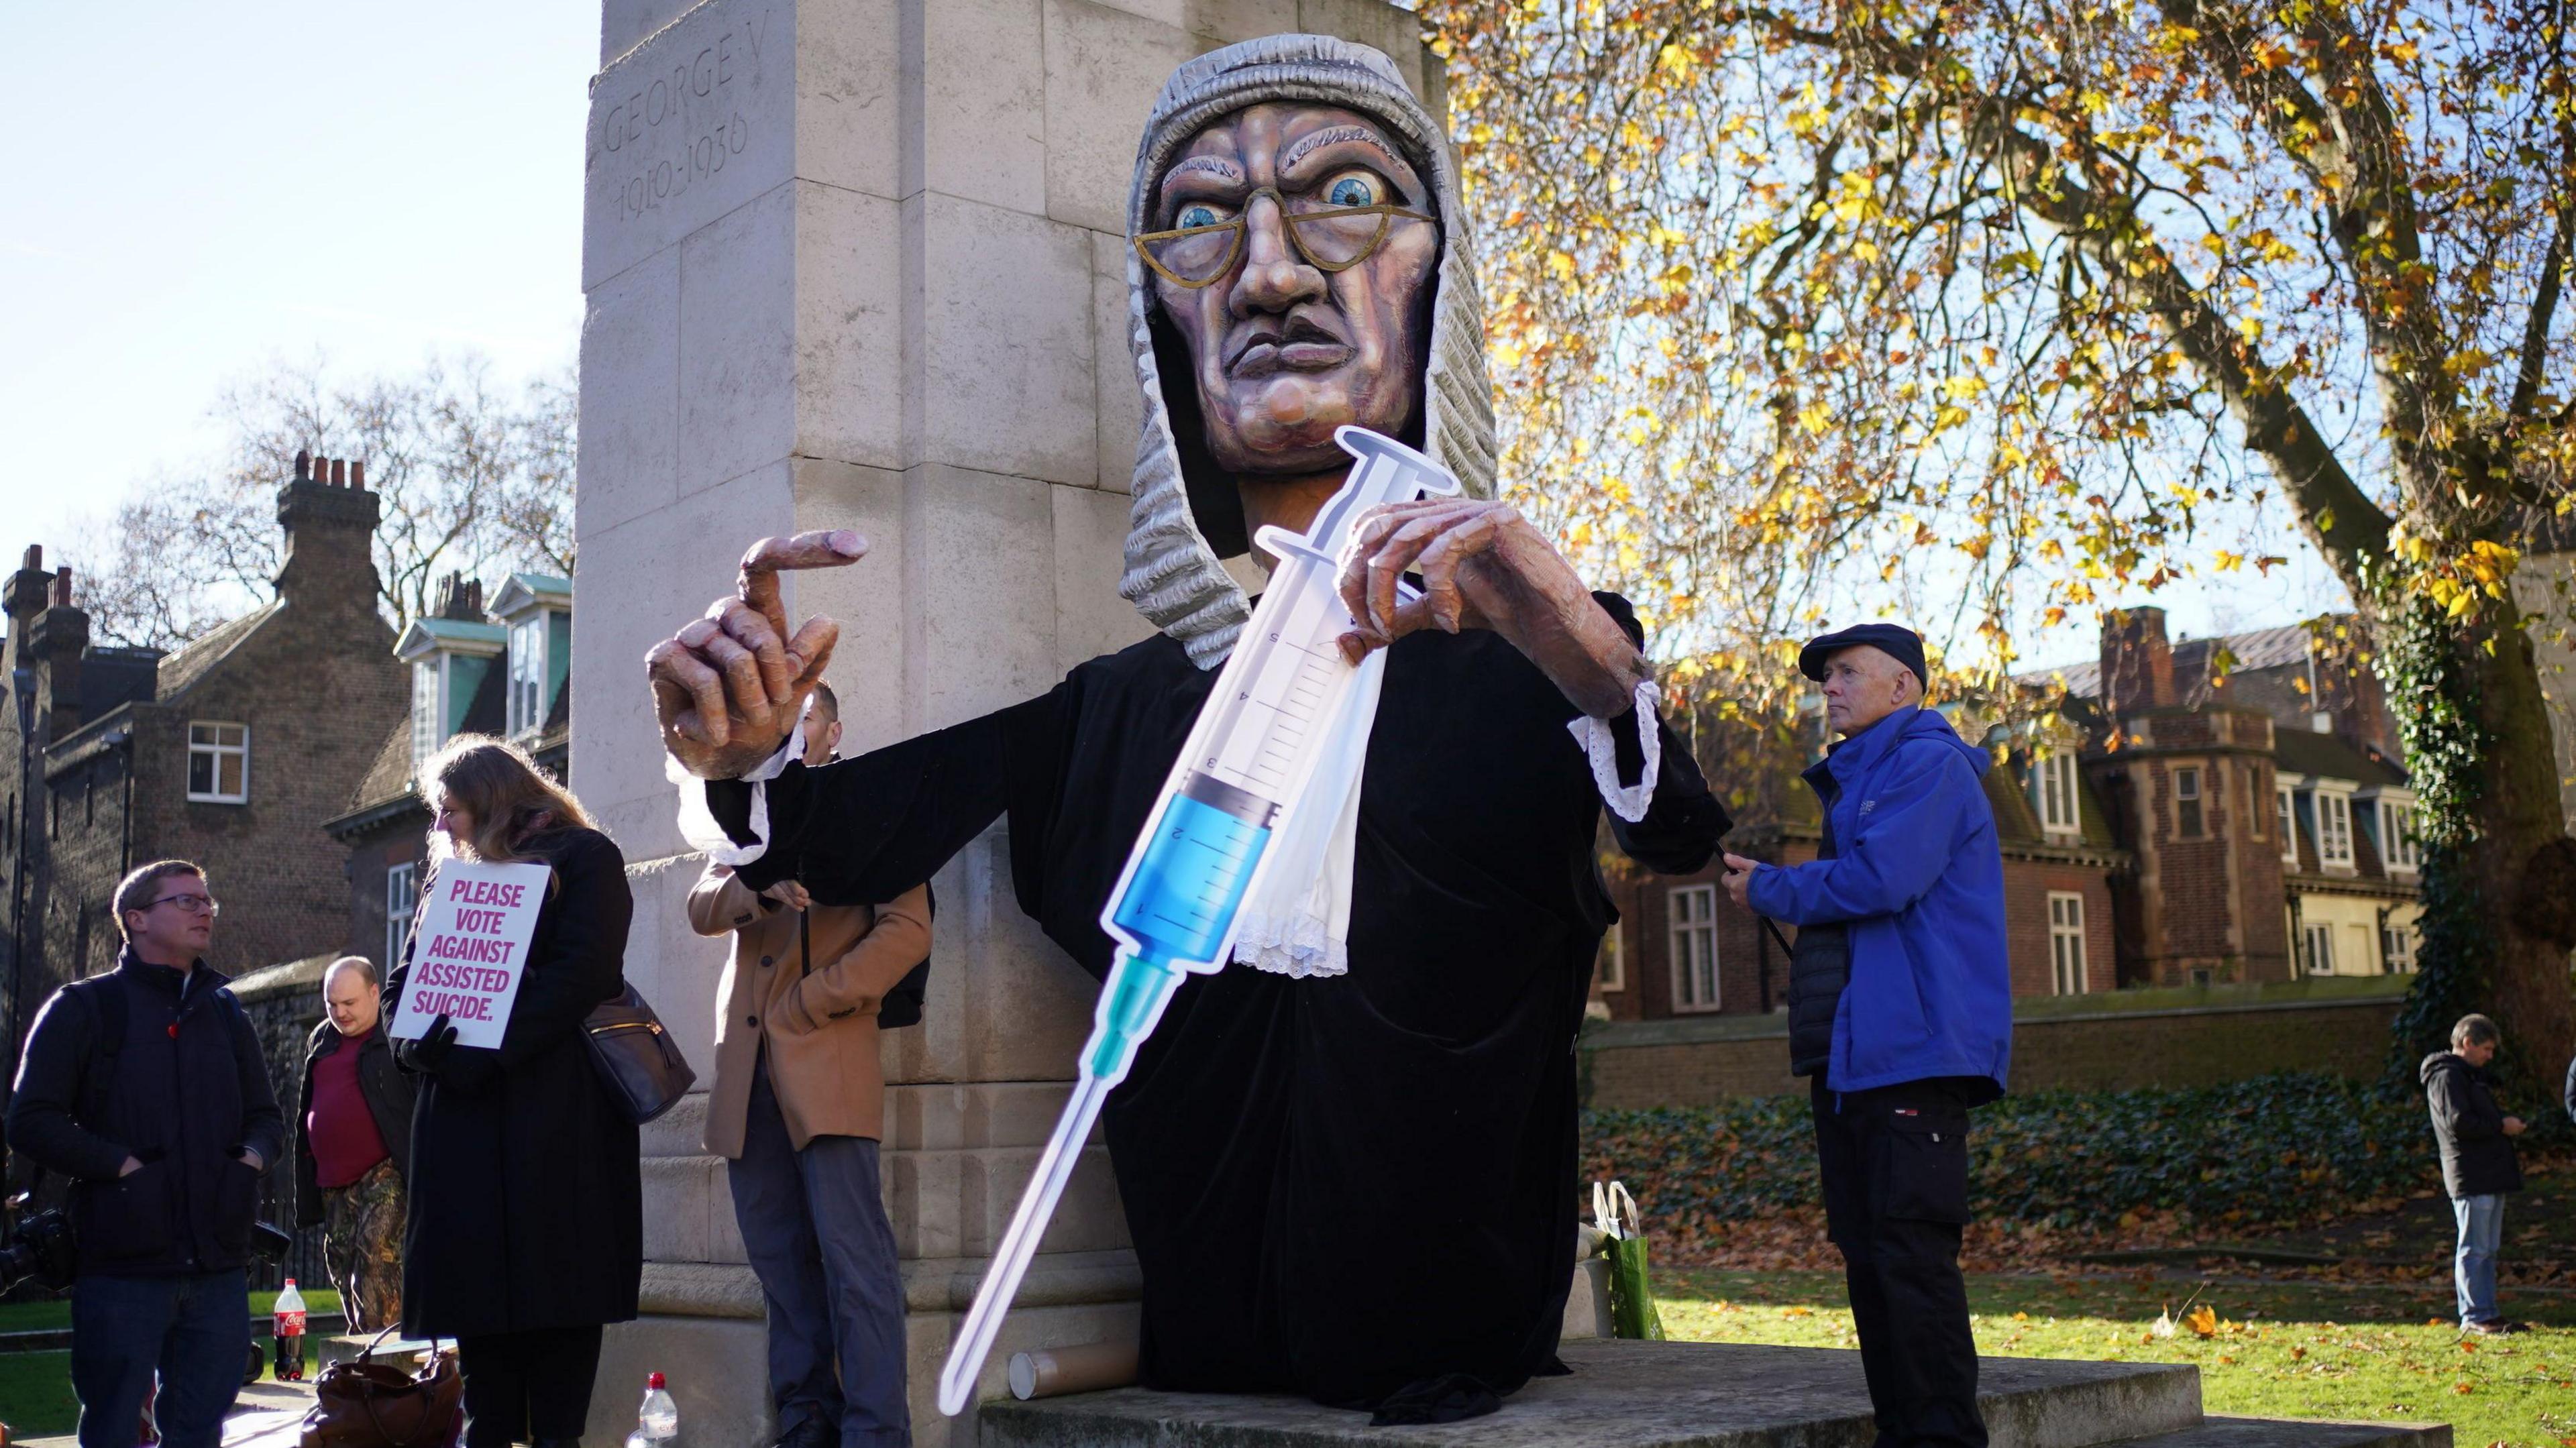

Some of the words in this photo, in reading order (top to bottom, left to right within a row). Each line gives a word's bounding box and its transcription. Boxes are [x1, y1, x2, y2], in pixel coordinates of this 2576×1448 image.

[604, 32, 735, 153] GEORGE
[745, 9, 770, 62] V
[1269, 632, 1280, 643] 5
[1239, 691, 1249, 700] 4
[1207, 757, 1218, 769] 3
[1171, 826, 1184, 839] 2
[449, 879, 525, 907] PLEASE
[455, 908, 506, 935] VOTE
[428, 935, 515, 964] AGAINST
[415, 962, 509, 993] ASSISTED
[412, 990, 494, 1021] SUICIDE.
